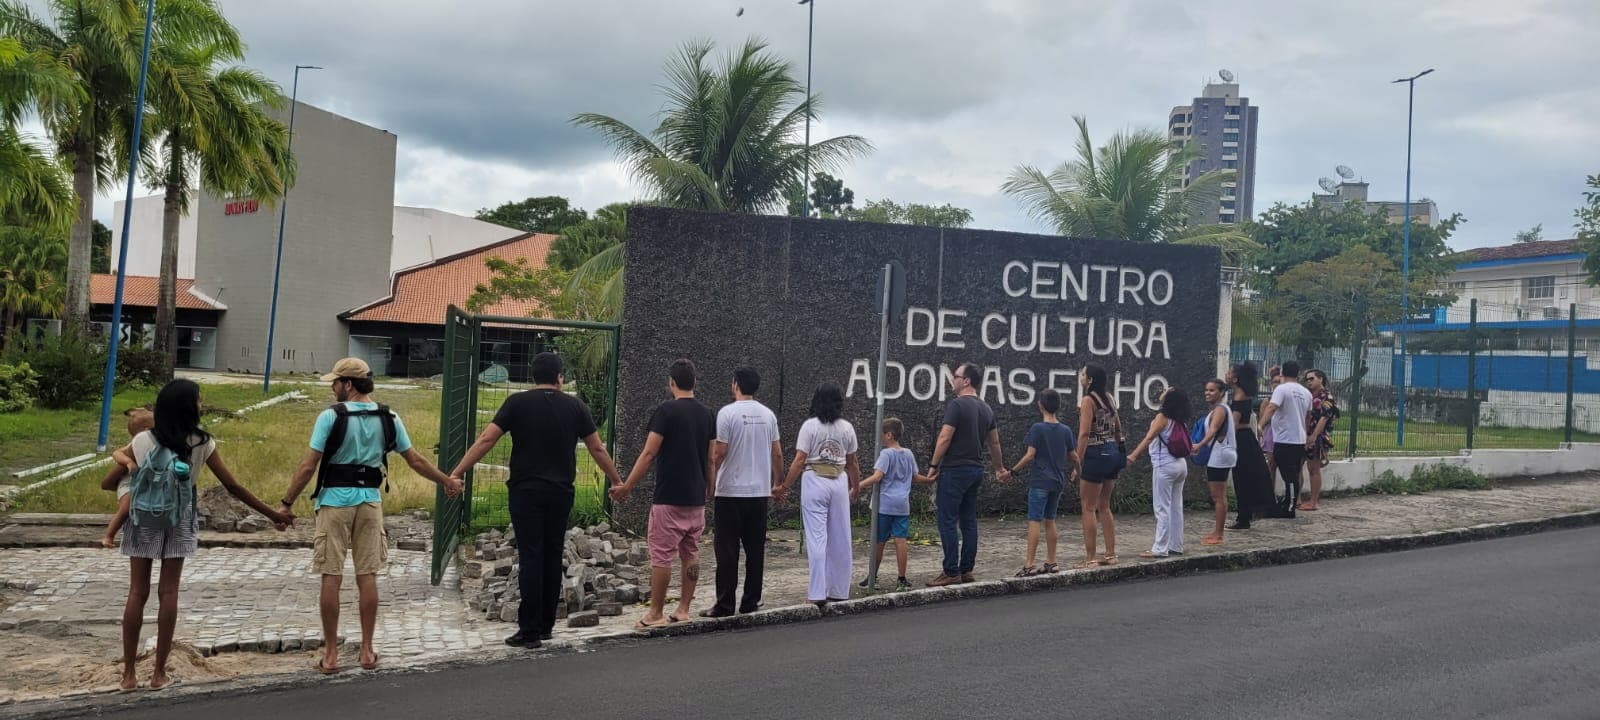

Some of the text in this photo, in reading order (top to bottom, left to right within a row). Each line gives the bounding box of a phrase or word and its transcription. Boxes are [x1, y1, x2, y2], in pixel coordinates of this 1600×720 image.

[1002, 260, 1174, 306] CENTRO
[906, 307, 1171, 361] DE CULTURA
[846, 358, 1170, 411] ADONAS FIHO
